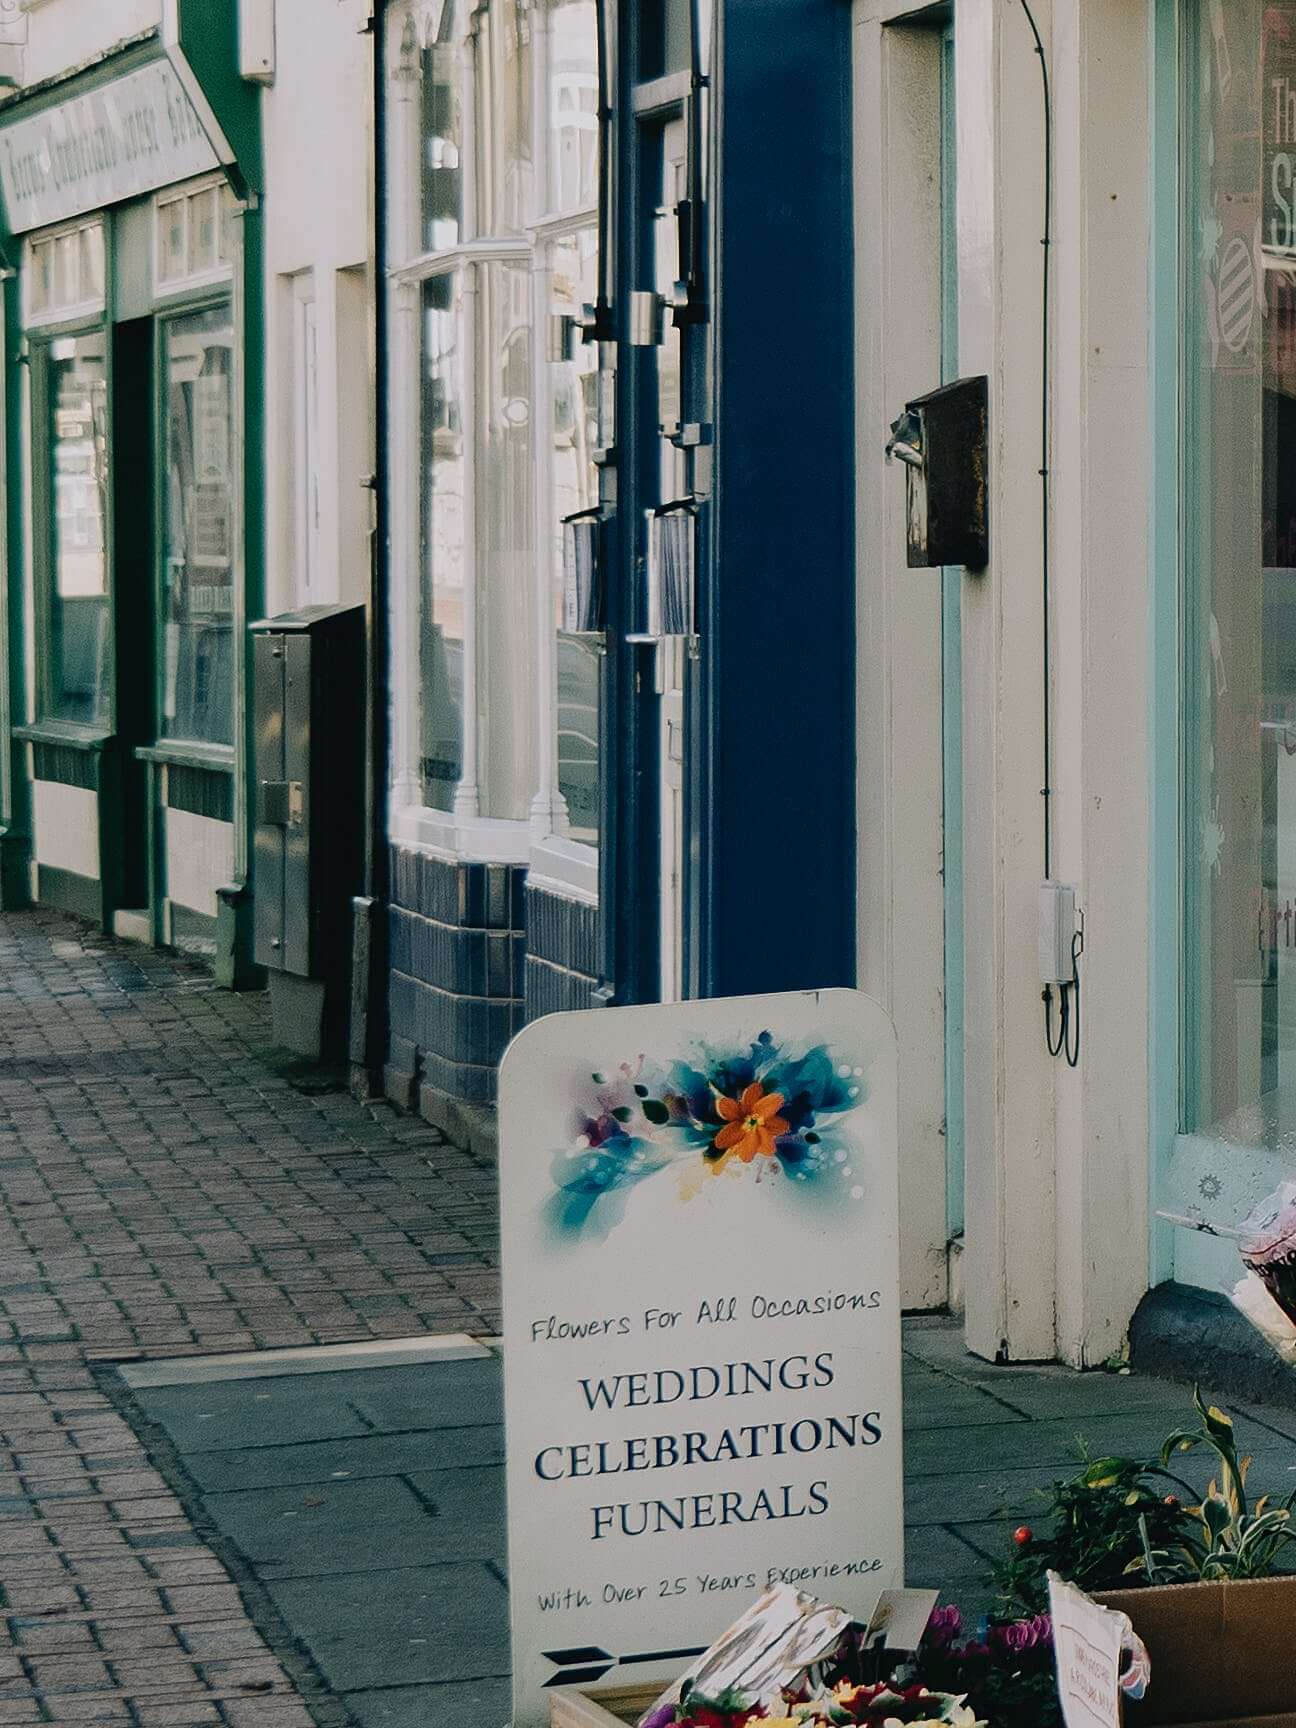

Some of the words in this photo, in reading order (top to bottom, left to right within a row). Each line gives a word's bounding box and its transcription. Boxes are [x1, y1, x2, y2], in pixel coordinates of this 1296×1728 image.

[530, 1312, 630, 1343] Flowers
[643, 1306, 682, 1332] For
[696, 1296, 738, 1327] All
[751, 1288, 882, 1319] Occasions
[577, 1352, 835, 1412] WEDDINGS
[533, 1410, 883, 1481] CELEBRATIONS
[590, 1479, 831, 1541] FUNERALS
[537, 1587, 592, 1613] With
[601, 1580, 647, 1606] Over
[658, 1576, 687, 1597] 25
[698, 1569, 757, 1594] Years
[765, 1554, 883, 1587] Experience
